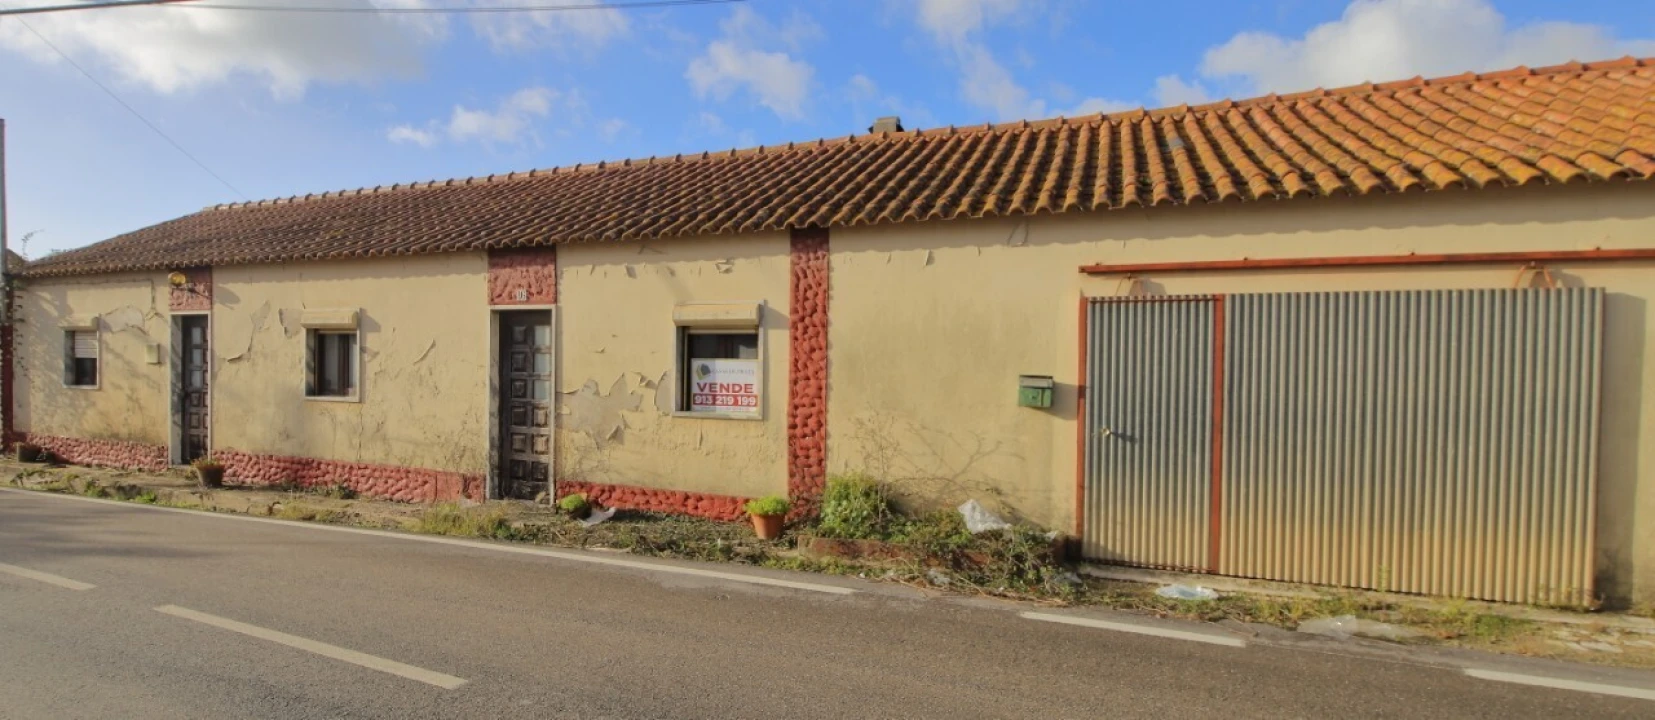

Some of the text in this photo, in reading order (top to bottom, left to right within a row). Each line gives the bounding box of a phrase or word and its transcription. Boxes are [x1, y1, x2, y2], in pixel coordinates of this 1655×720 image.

[696, 382, 754, 394] VENDE
[694, 395, 756, 406] 913 219 199
